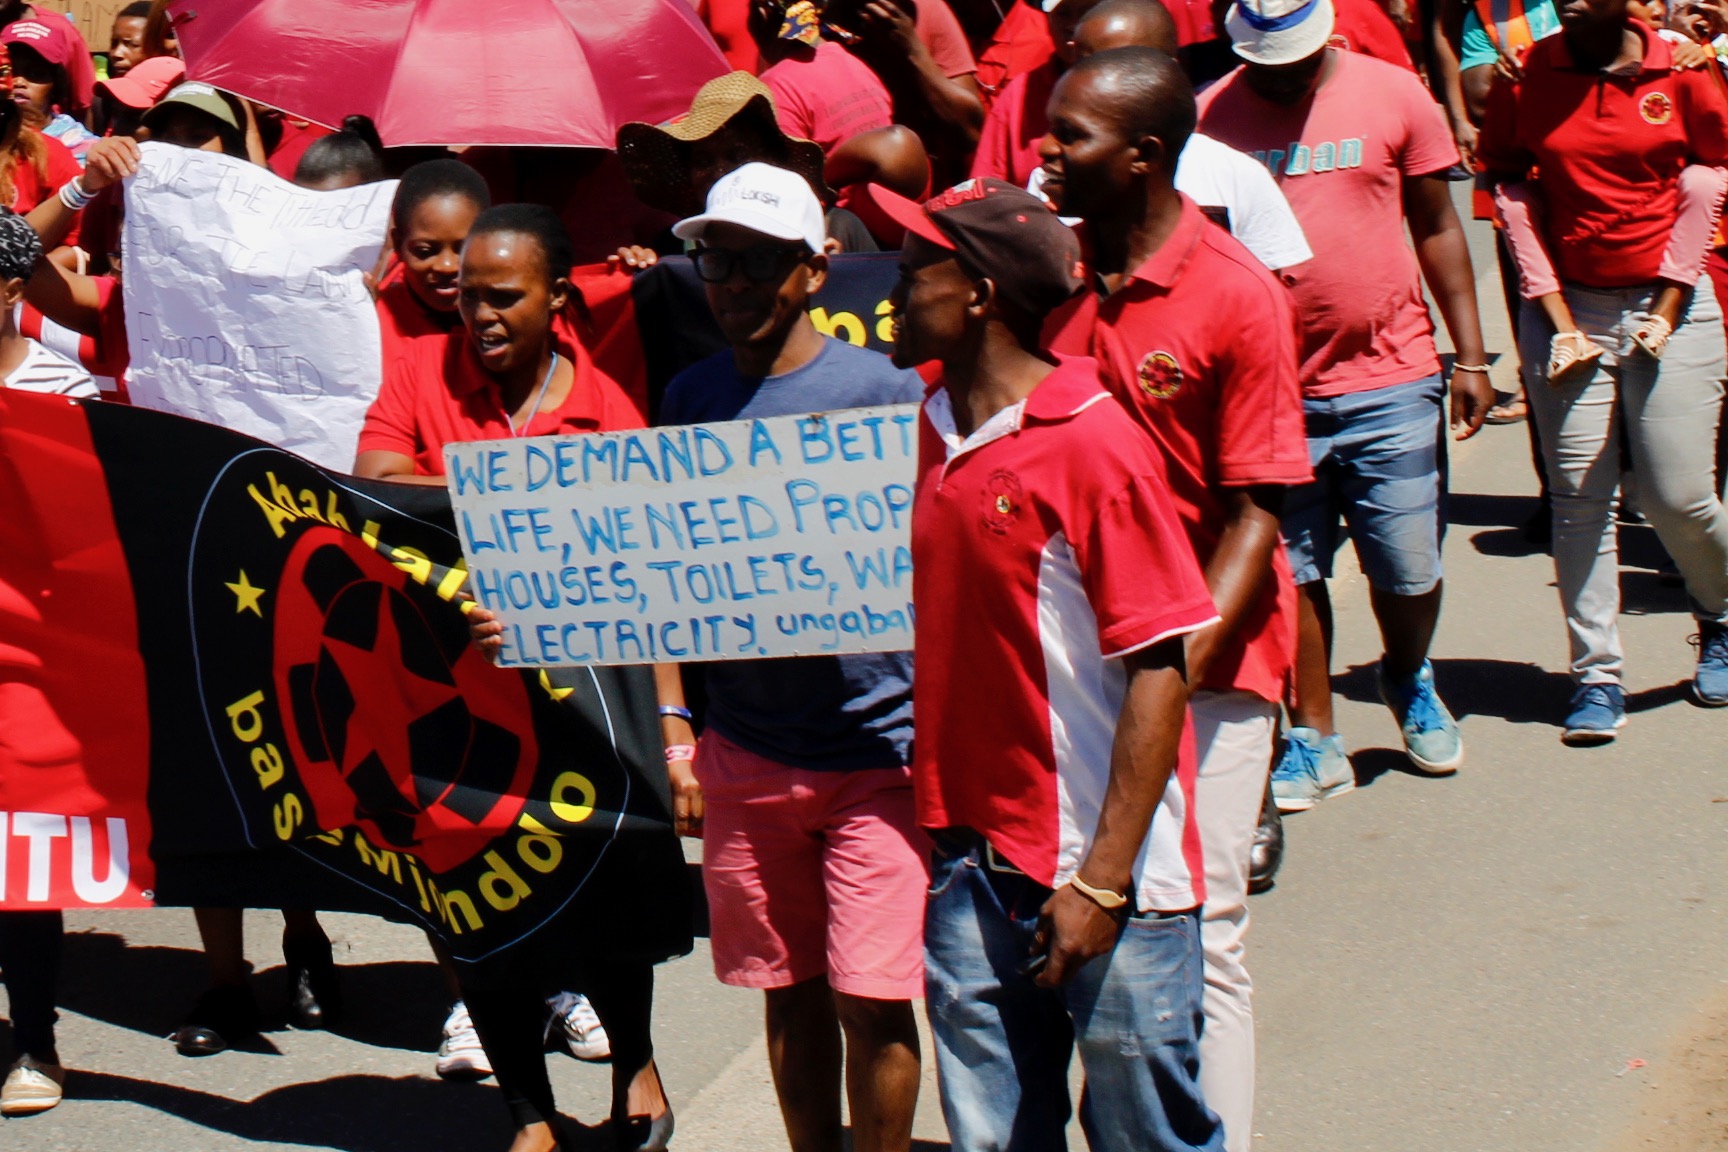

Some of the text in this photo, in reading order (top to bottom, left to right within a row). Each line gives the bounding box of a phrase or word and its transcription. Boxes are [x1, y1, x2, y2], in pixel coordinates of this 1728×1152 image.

[213, 162, 271, 215] THE
[451, 450, 513, 496] WE
[525, 426, 735, 493] DEMAND
[748, 418, 782, 467] A
[461, 506, 572, 565] LIFE,
[571, 506, 640, 556] WE
[645, 494, 780, 550] NEED
[474, 560, 649, 616] HOUSES,
[646, 551, 842, 608] TOILETS,
